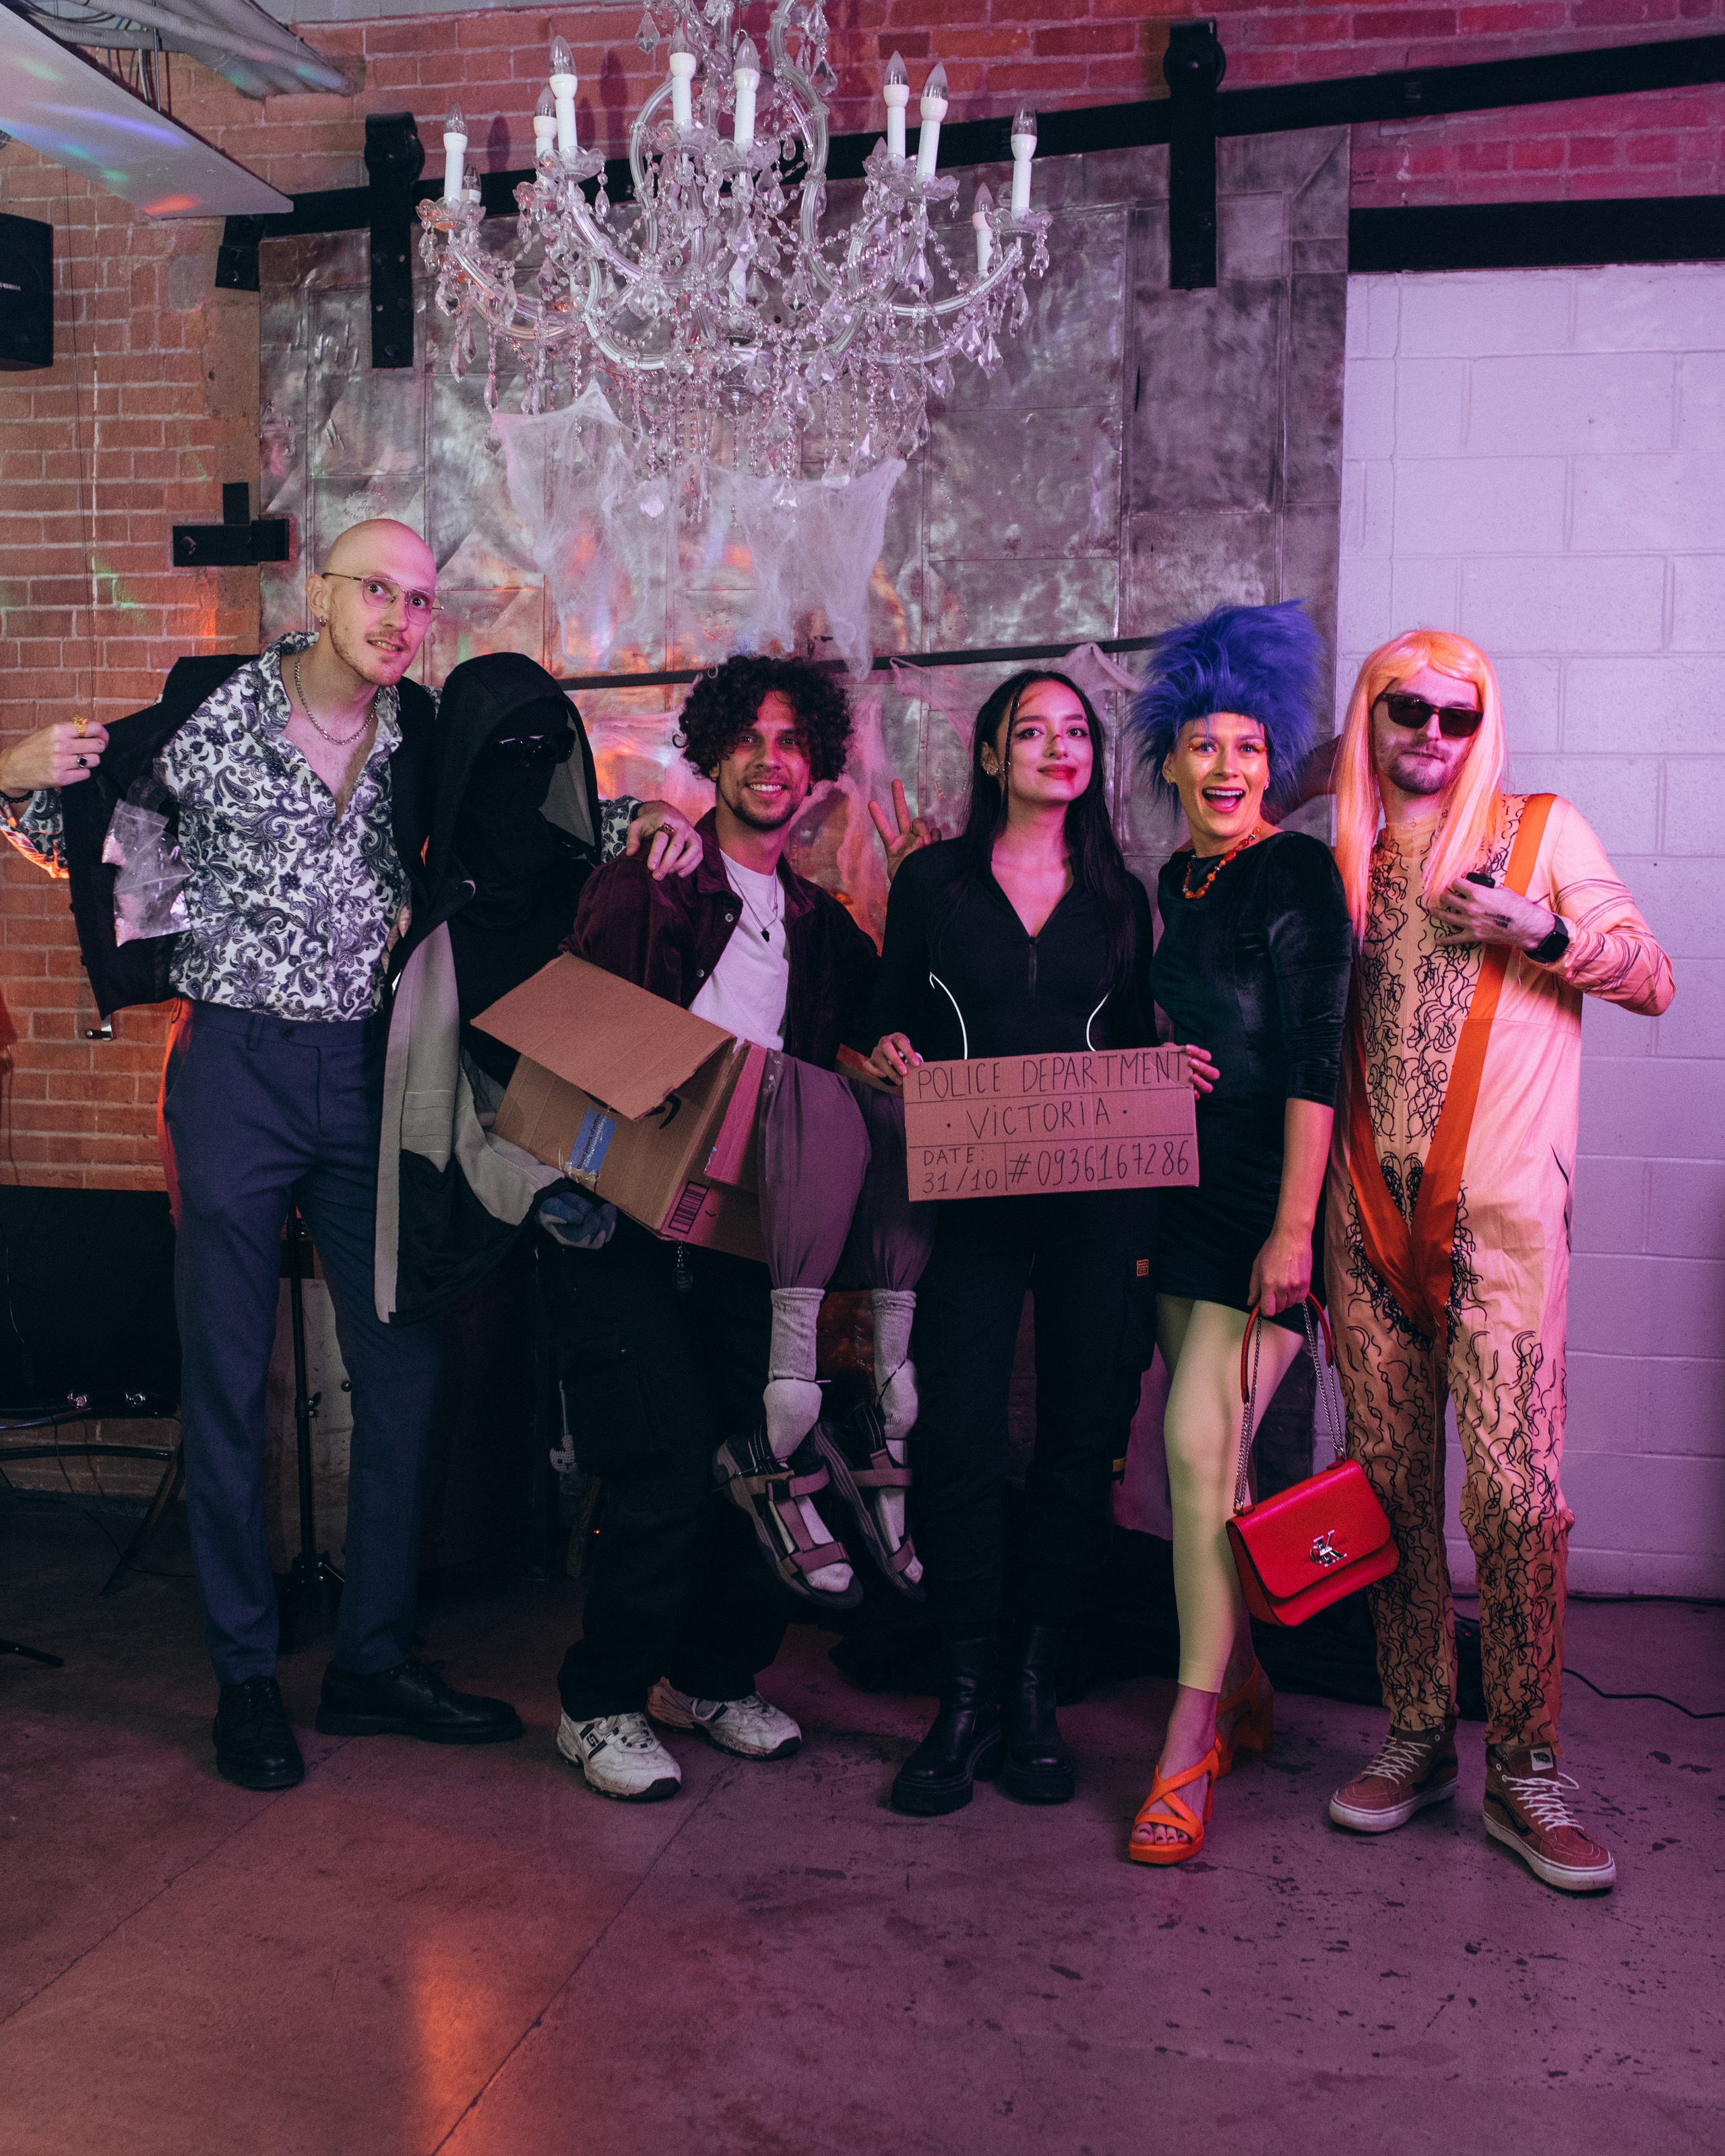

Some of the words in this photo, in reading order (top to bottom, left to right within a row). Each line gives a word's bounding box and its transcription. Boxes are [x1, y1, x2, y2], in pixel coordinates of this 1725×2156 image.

[918, 1062, 1001, 1100] POLICE
[1022, 1051, 1186, 1093] DEPARTMENT
[584, 1137, 593, 1154] jours
[590, 1113, 601, 1135] d'offre
[923, 1147, 984, 1166] DATE:
[922, 1167, 998, 1193] 31/10
